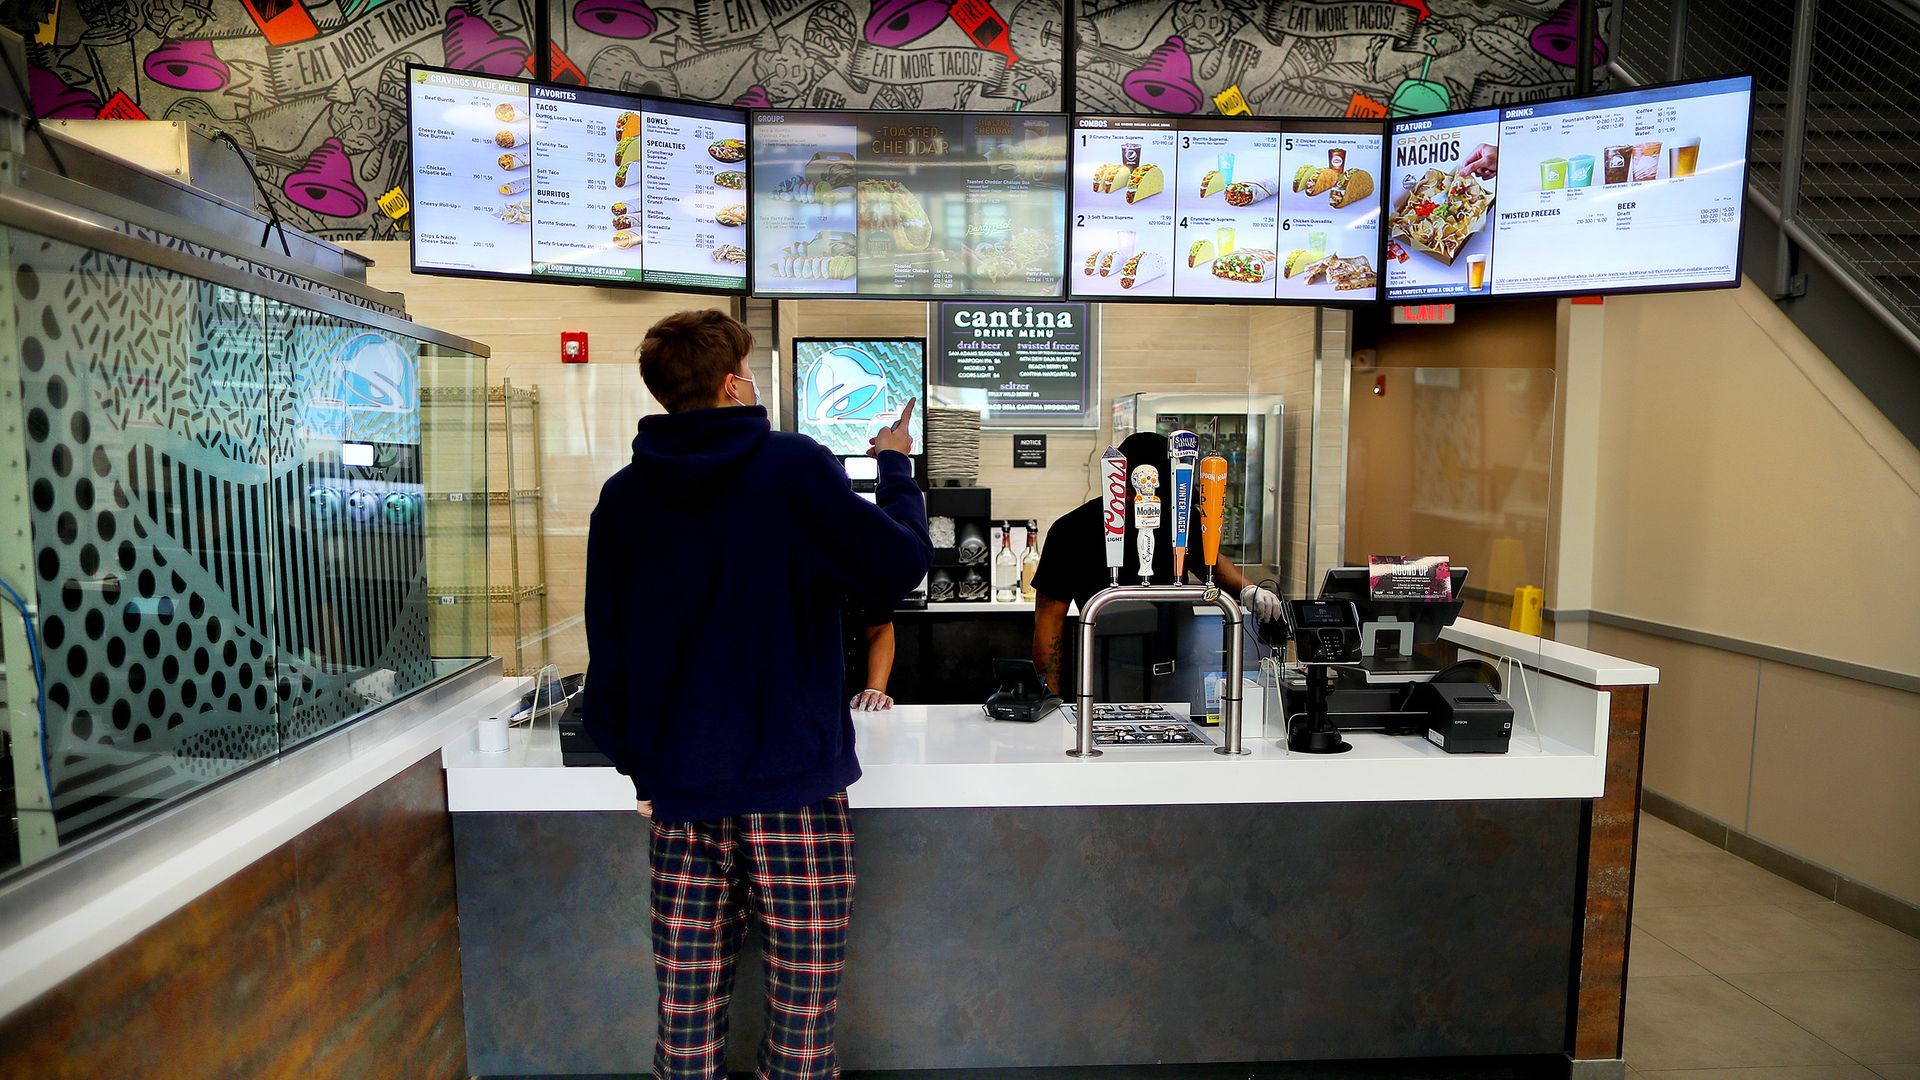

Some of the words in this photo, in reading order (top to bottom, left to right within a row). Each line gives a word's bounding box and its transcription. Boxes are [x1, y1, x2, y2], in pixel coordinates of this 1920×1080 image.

[726, 4, 759, 34] EAT
[955, 0, 986, 28] FIRE!
[1287, 6, 1312, 32] EAT
[1315, 5, 1351, 33] MORE
[1354, 6, 1397, 31] TACOS!
[299, 47, 336, 86] EAT
[338, 22, 385, 72] MORE
[380, 2, 444, 44] TACOS!
[872, 52, 899, 77] EAT
[901, 52, 936, 79] MORE
[939, 51, 984, 77] TACOS!
[430, 74, 470, 86] CRAVINGS
[471, 80, 496, 91] VALUE
[498, 83, 520, 93] MENU
[535, 87, 577, 100] FAVORITES
[535, 103, 558, 112] TACOS
[1220, 93, 1242, 112] MILD
[1505, 107, 1534, 118] DRINKS
[646, 116, 668, 126] BOWLS
[1079, 119, 1108, 128] COMBOS
[1561, 116, 1585, 124] Fountain
[1585, 114, 1603, 122] Drinks
[417, 126, 436, 134] Cheesy
[882, 126, 939, 137] TOASTED
[1395, 121, 1433, 132] FEATURED
[536, 140, 557, 148] Crunchy
[1081, 134, 1087, 146] 1
[1182, 136, 1191, 148] 3
[1285, 138, 1294, 150] 5
[1396, 131, 1462, 146] GRANDE
[646, 139, 686, 151] SPECIALTIES
[872, 139, 950, 155] CHEDDAR
[646, 149, 674, 158] Crunchwrap
[1396, 140, 1460, 168] NACHOS
[537, 188, 571, 199] BURRITOS
[385, 194, 405, 215] MILD
[1617, 201, 1636, 211] BEER
[1076, 214, 1085, 227] 2
[1500, 211, 1530, 221] TWISTED
[1530, 208, 1561, 219] FREEZES
[1179, 216, 1188, 229] 4
[1282, 219, 1291, 231] 6
[547, 264, 574, 273] LOOKING
[574, 266, 587, 274] FOR
[587, 267, 627, 277] VEGETARIAN?
[954, 306, 1074, 329] cantina
[973, 329, 1015, 338] DRINK
[1018, 329, 1055, 338] MENU
[957, 341, 980, 349] draft
[981, 341, 1002, 349] beer
[1017, 341, 1051, 350] twisted
[1052, 341, 1080, 350] freeze
[999, 381, 1031, 390] seltzer
[1174, 434, 1197, 444] SAMUEL
[1104, 459, 1127, 536] Coors
[1178, 483, 1187, 509] WINTER
[1136, 506, 1161, 517] Modelo
[1178, 510, 1187, 534] LAGER
[1391, 564, 1417, 576] ROUND
[1418, 564, 1429, 575] UP
